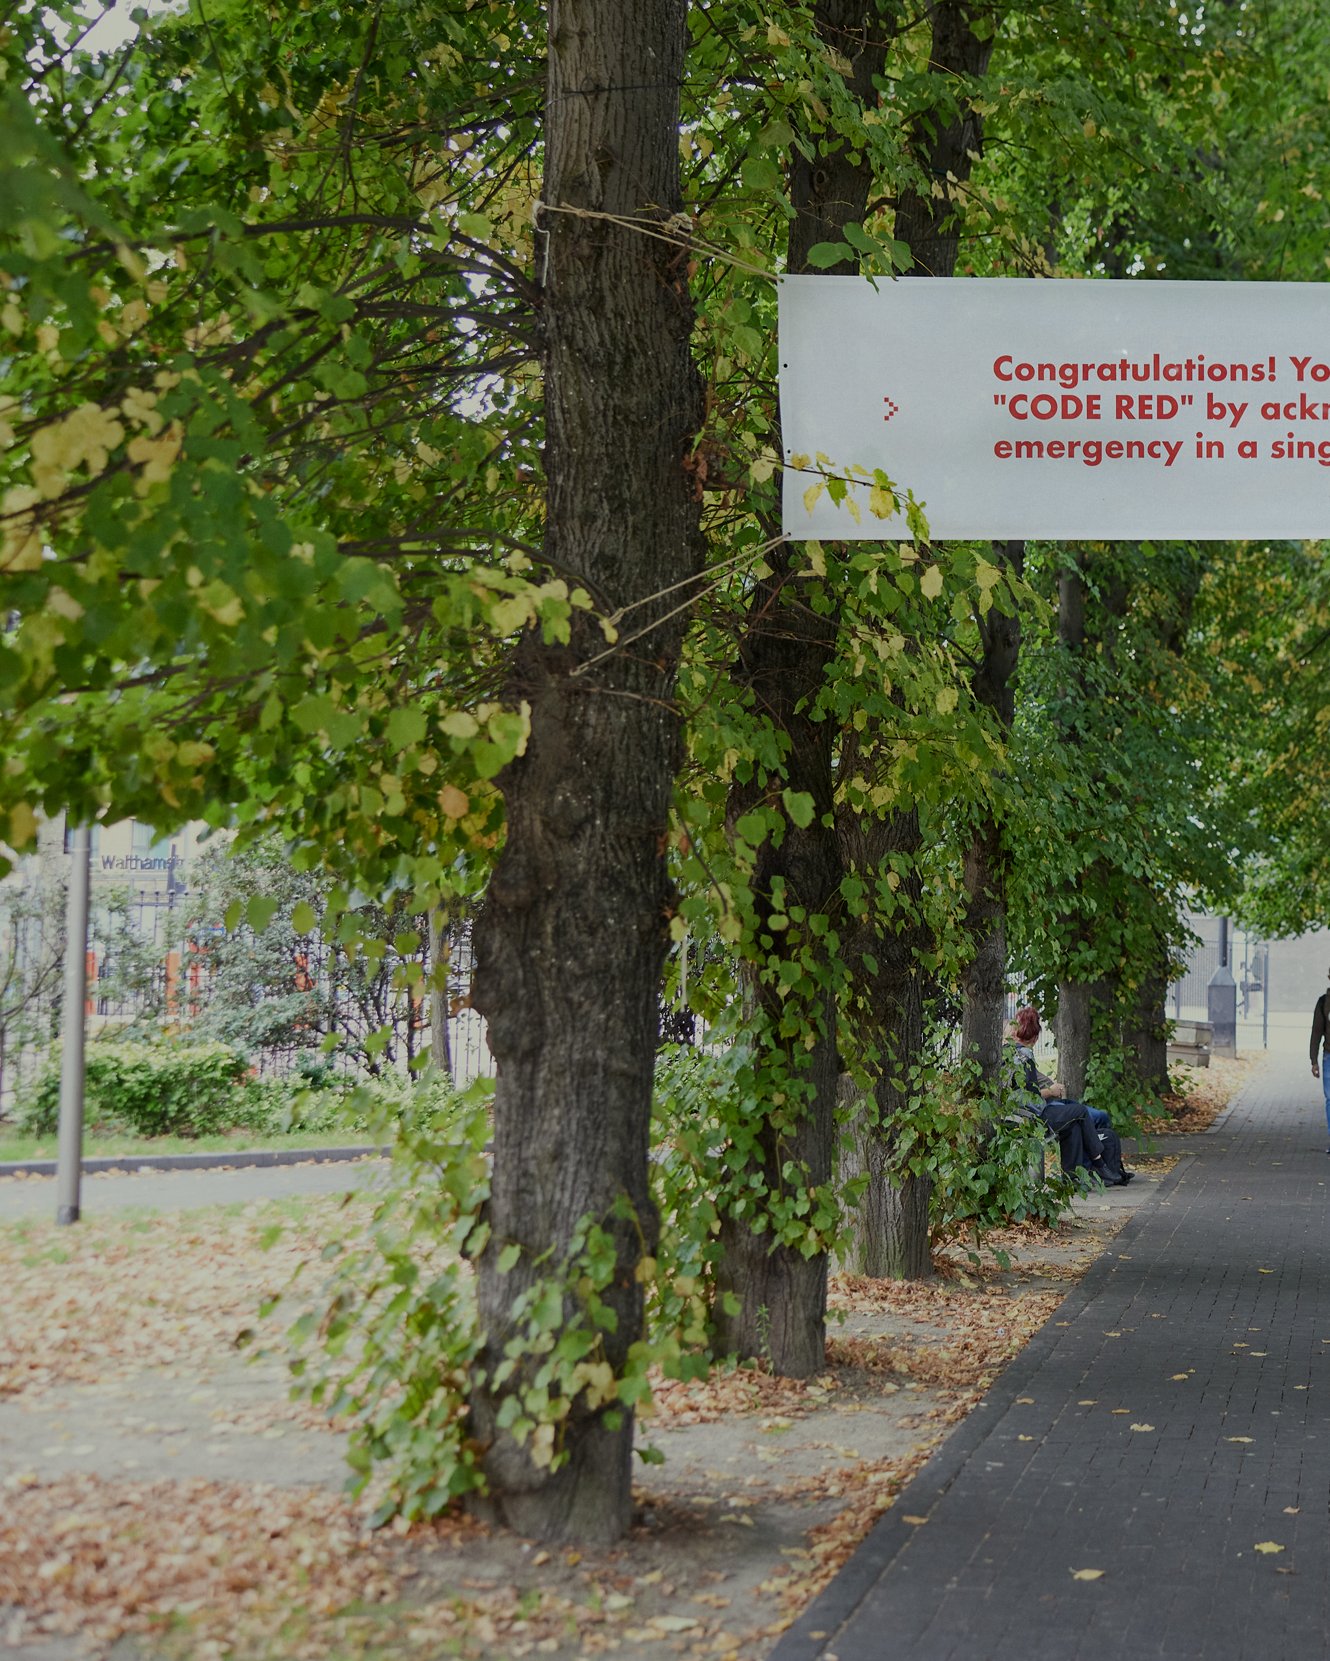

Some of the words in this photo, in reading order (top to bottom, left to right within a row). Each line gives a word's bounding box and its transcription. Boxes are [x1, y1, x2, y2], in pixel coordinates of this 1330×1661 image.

[994, 354, 1277, 390] Congratulations!
[994, 393, 1102, 421] "CODE
[1116, 394, 1194, 420] RED"
[1207, 392, 1249, 429] by
[994, 440, 1184, 467] emergency
[1196, 432, 1225, 459] in
[1238, 440, 1258, 459] a
